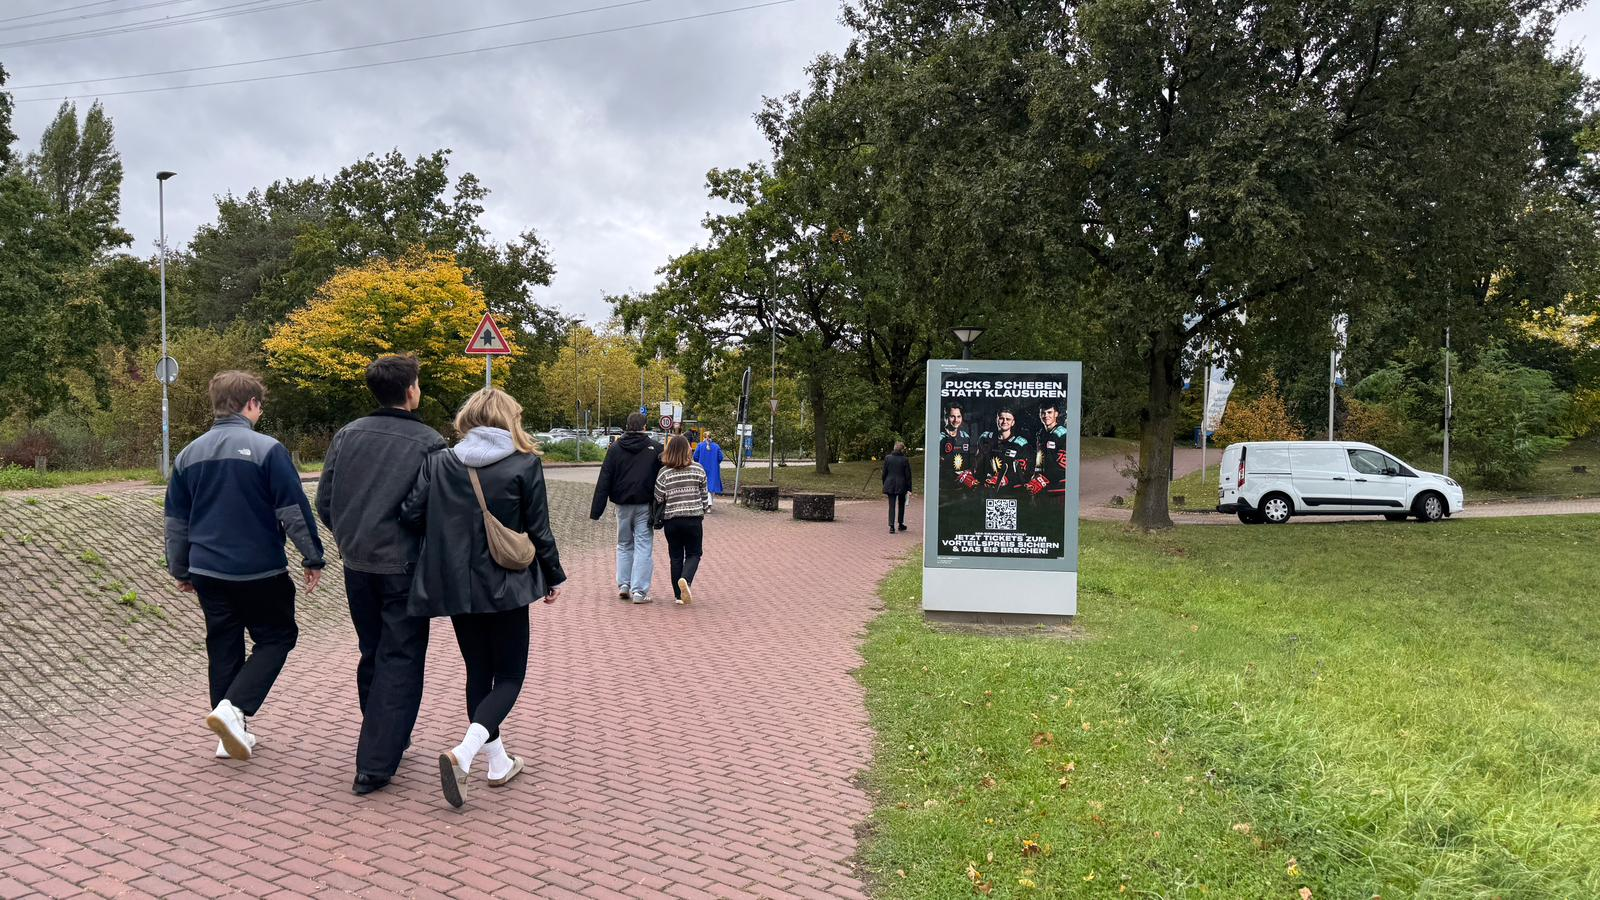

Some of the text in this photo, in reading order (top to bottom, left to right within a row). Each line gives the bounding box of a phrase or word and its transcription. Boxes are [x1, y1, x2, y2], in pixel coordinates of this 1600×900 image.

[945, 381, 1062, 390] PUCKS SCHIEBEN
[941, 389, 1067, 398] STATT KLAUSUREN
